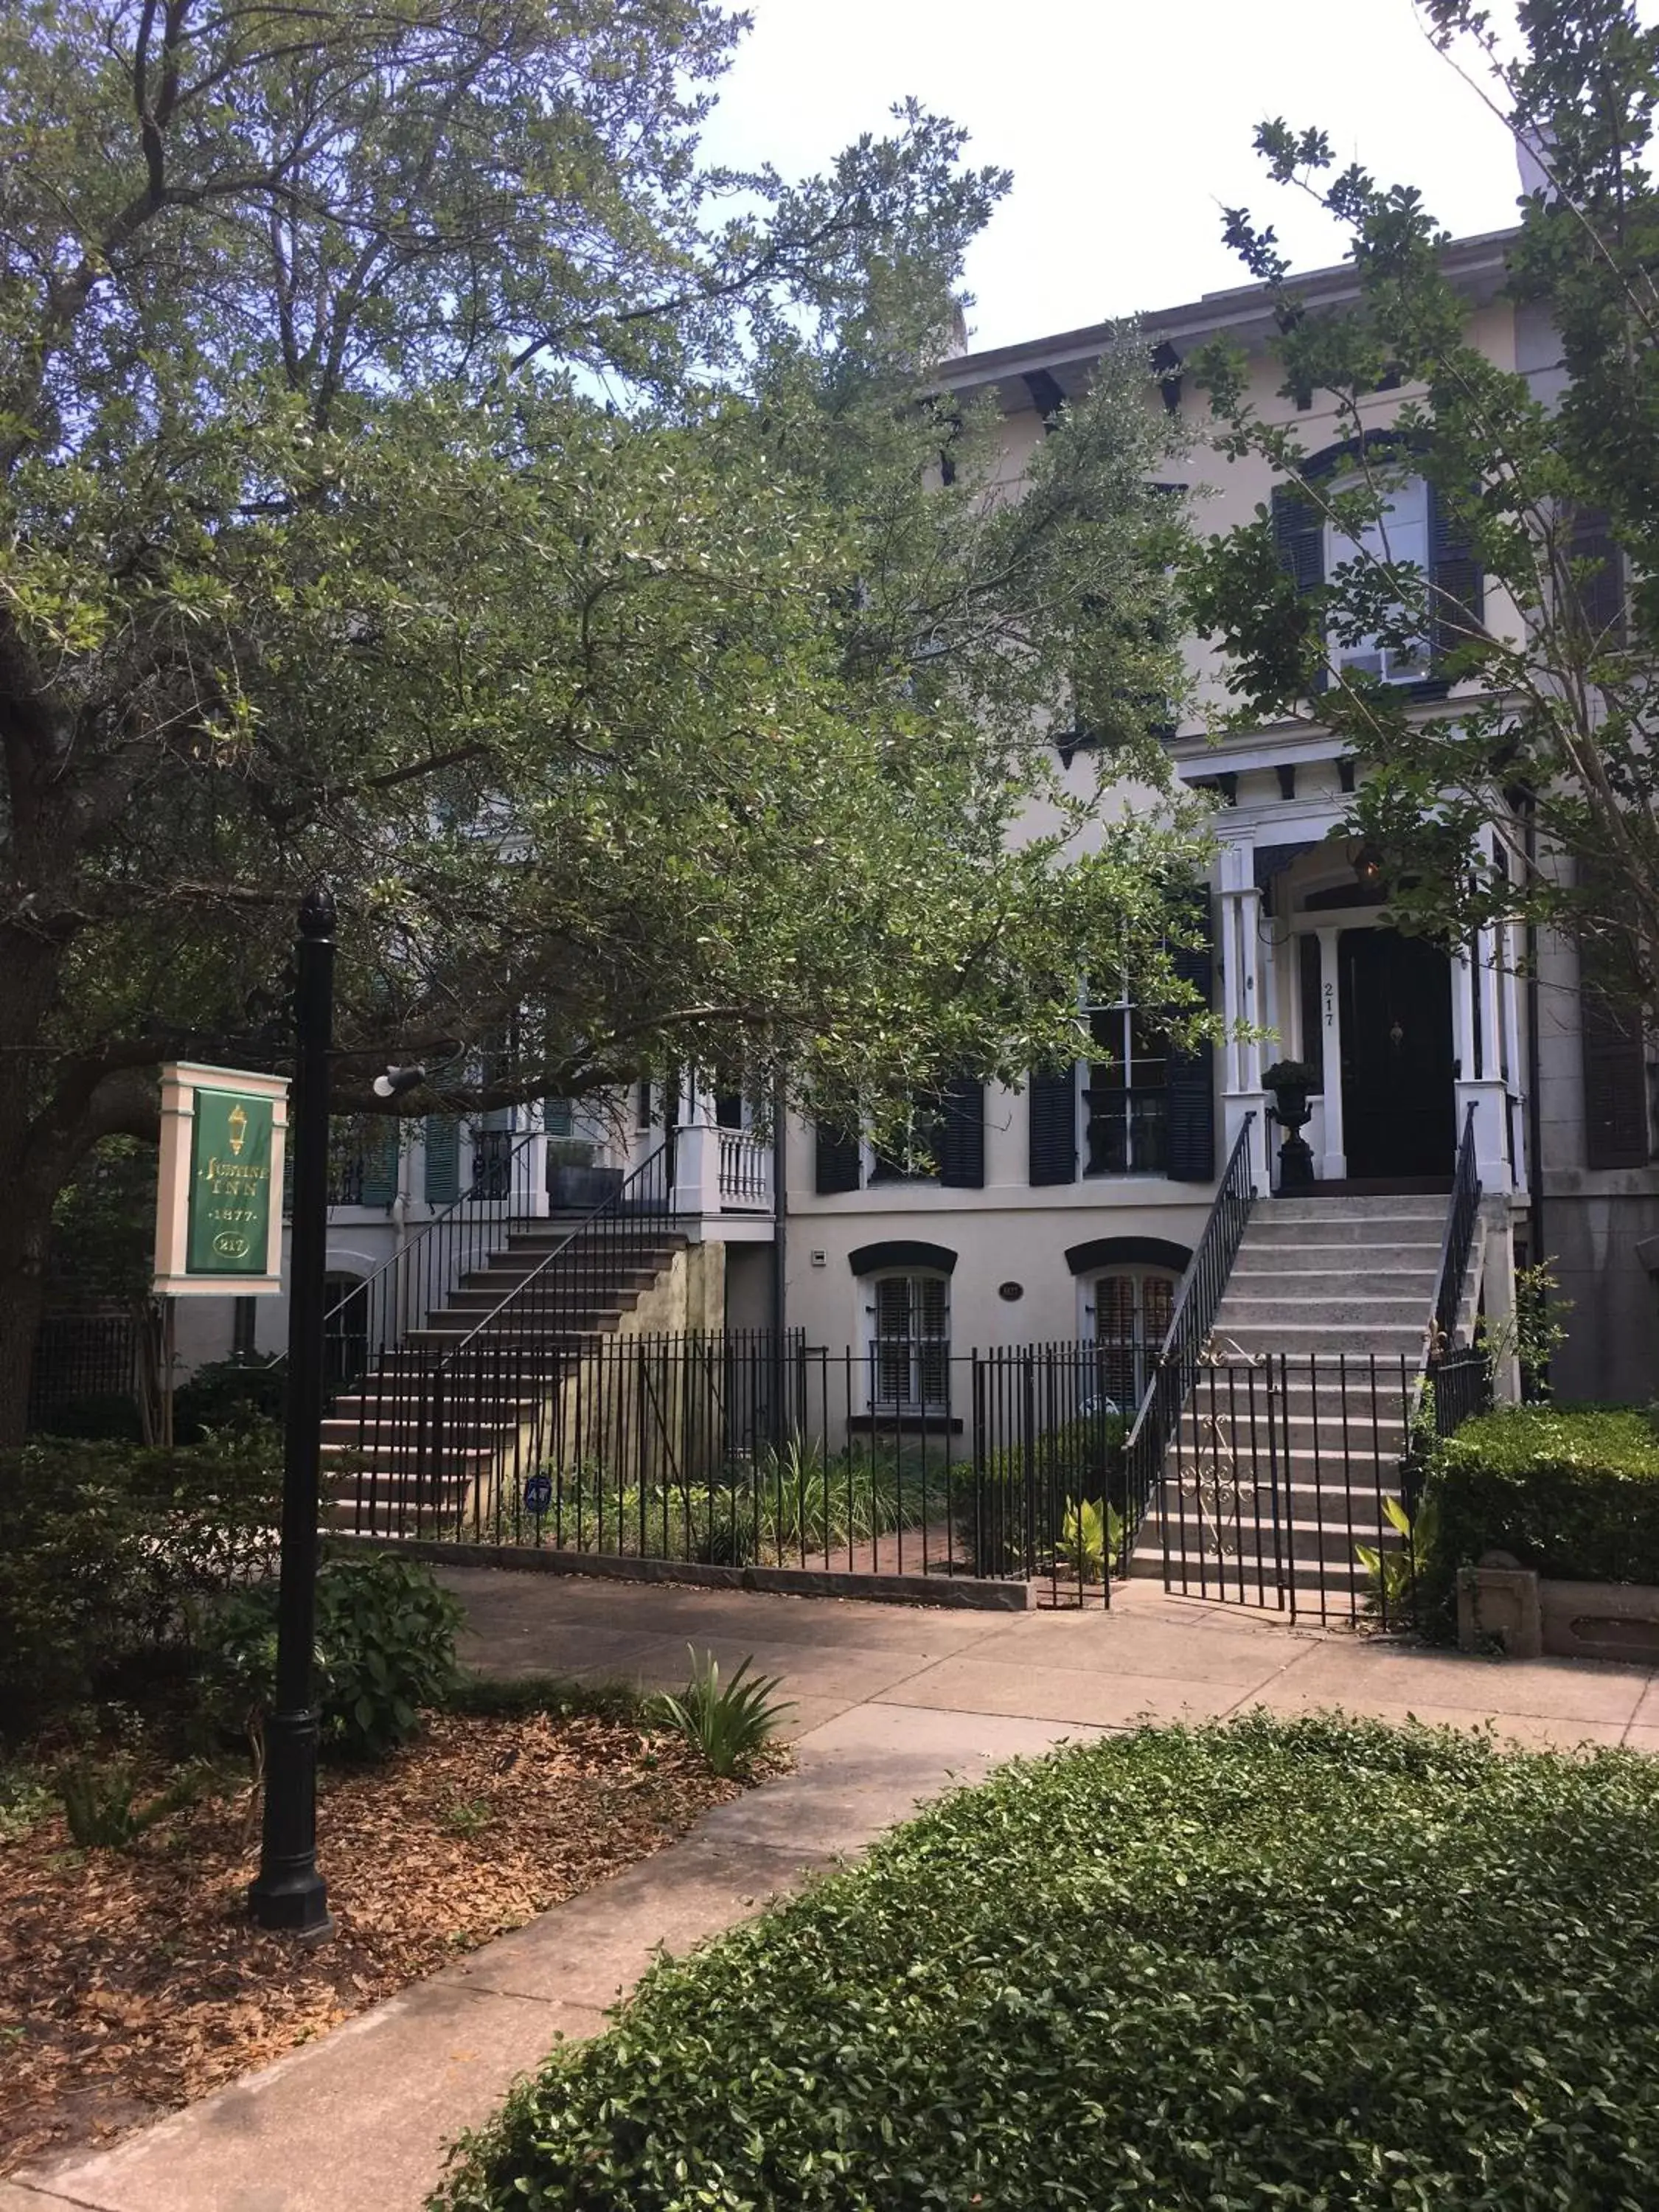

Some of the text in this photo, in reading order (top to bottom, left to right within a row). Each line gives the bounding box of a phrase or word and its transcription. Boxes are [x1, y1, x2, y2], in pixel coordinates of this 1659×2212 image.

[1324, 982, 1334, 1026] 217
[212, 1179, 256, 1197] INN
[219, 1239, 245, 1252] 217
